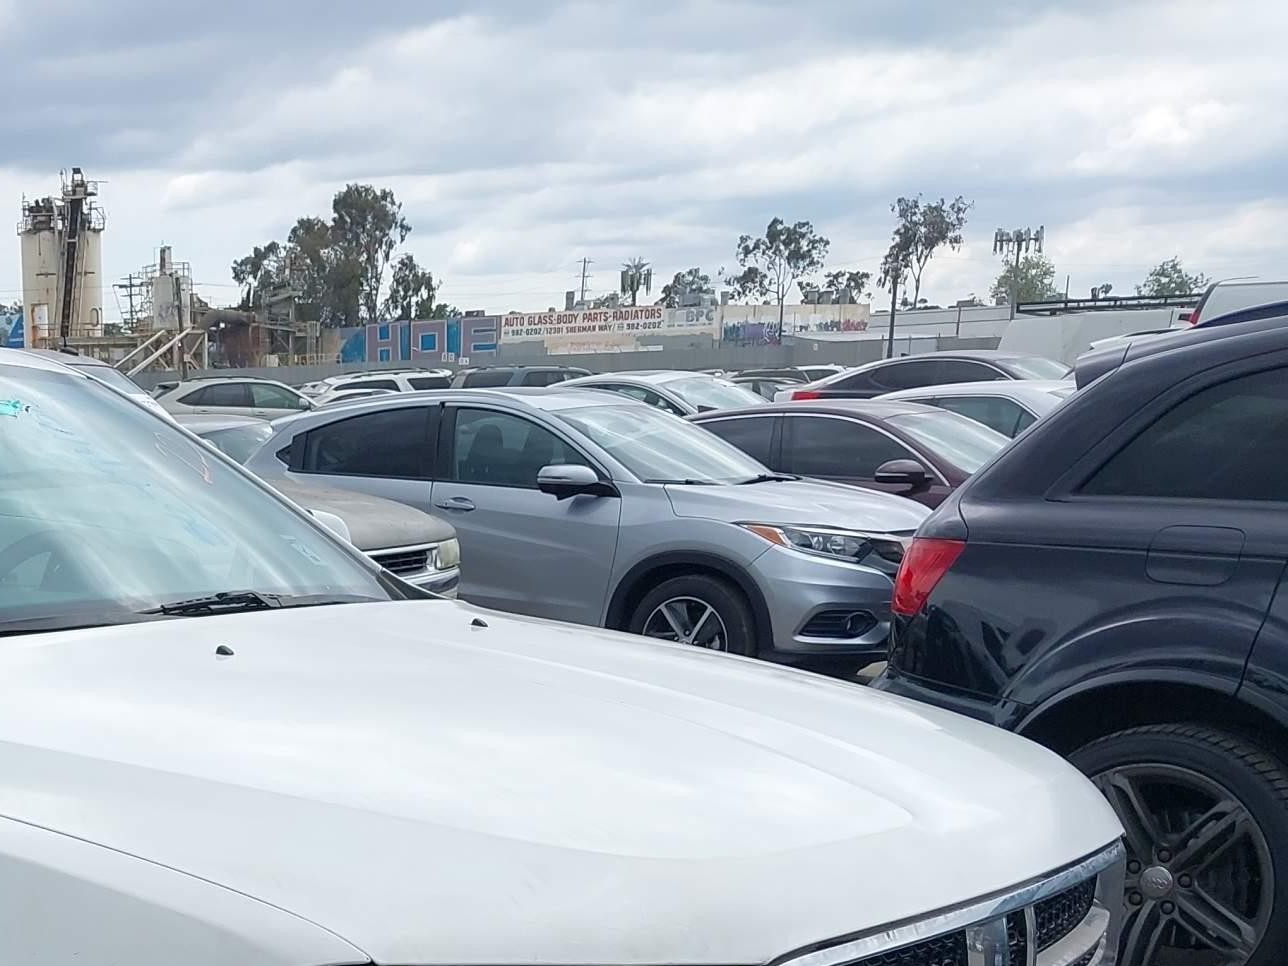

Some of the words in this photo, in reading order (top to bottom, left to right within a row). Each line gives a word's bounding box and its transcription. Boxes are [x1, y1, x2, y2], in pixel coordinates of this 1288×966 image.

[503, 316, 525, 328] AUTO
[527, 312, 579, 327] GLASS-BODY
[582, 308, 662, 323] PARTS-RADIATORS
[565, 324, 597, 334] SHERMAN
